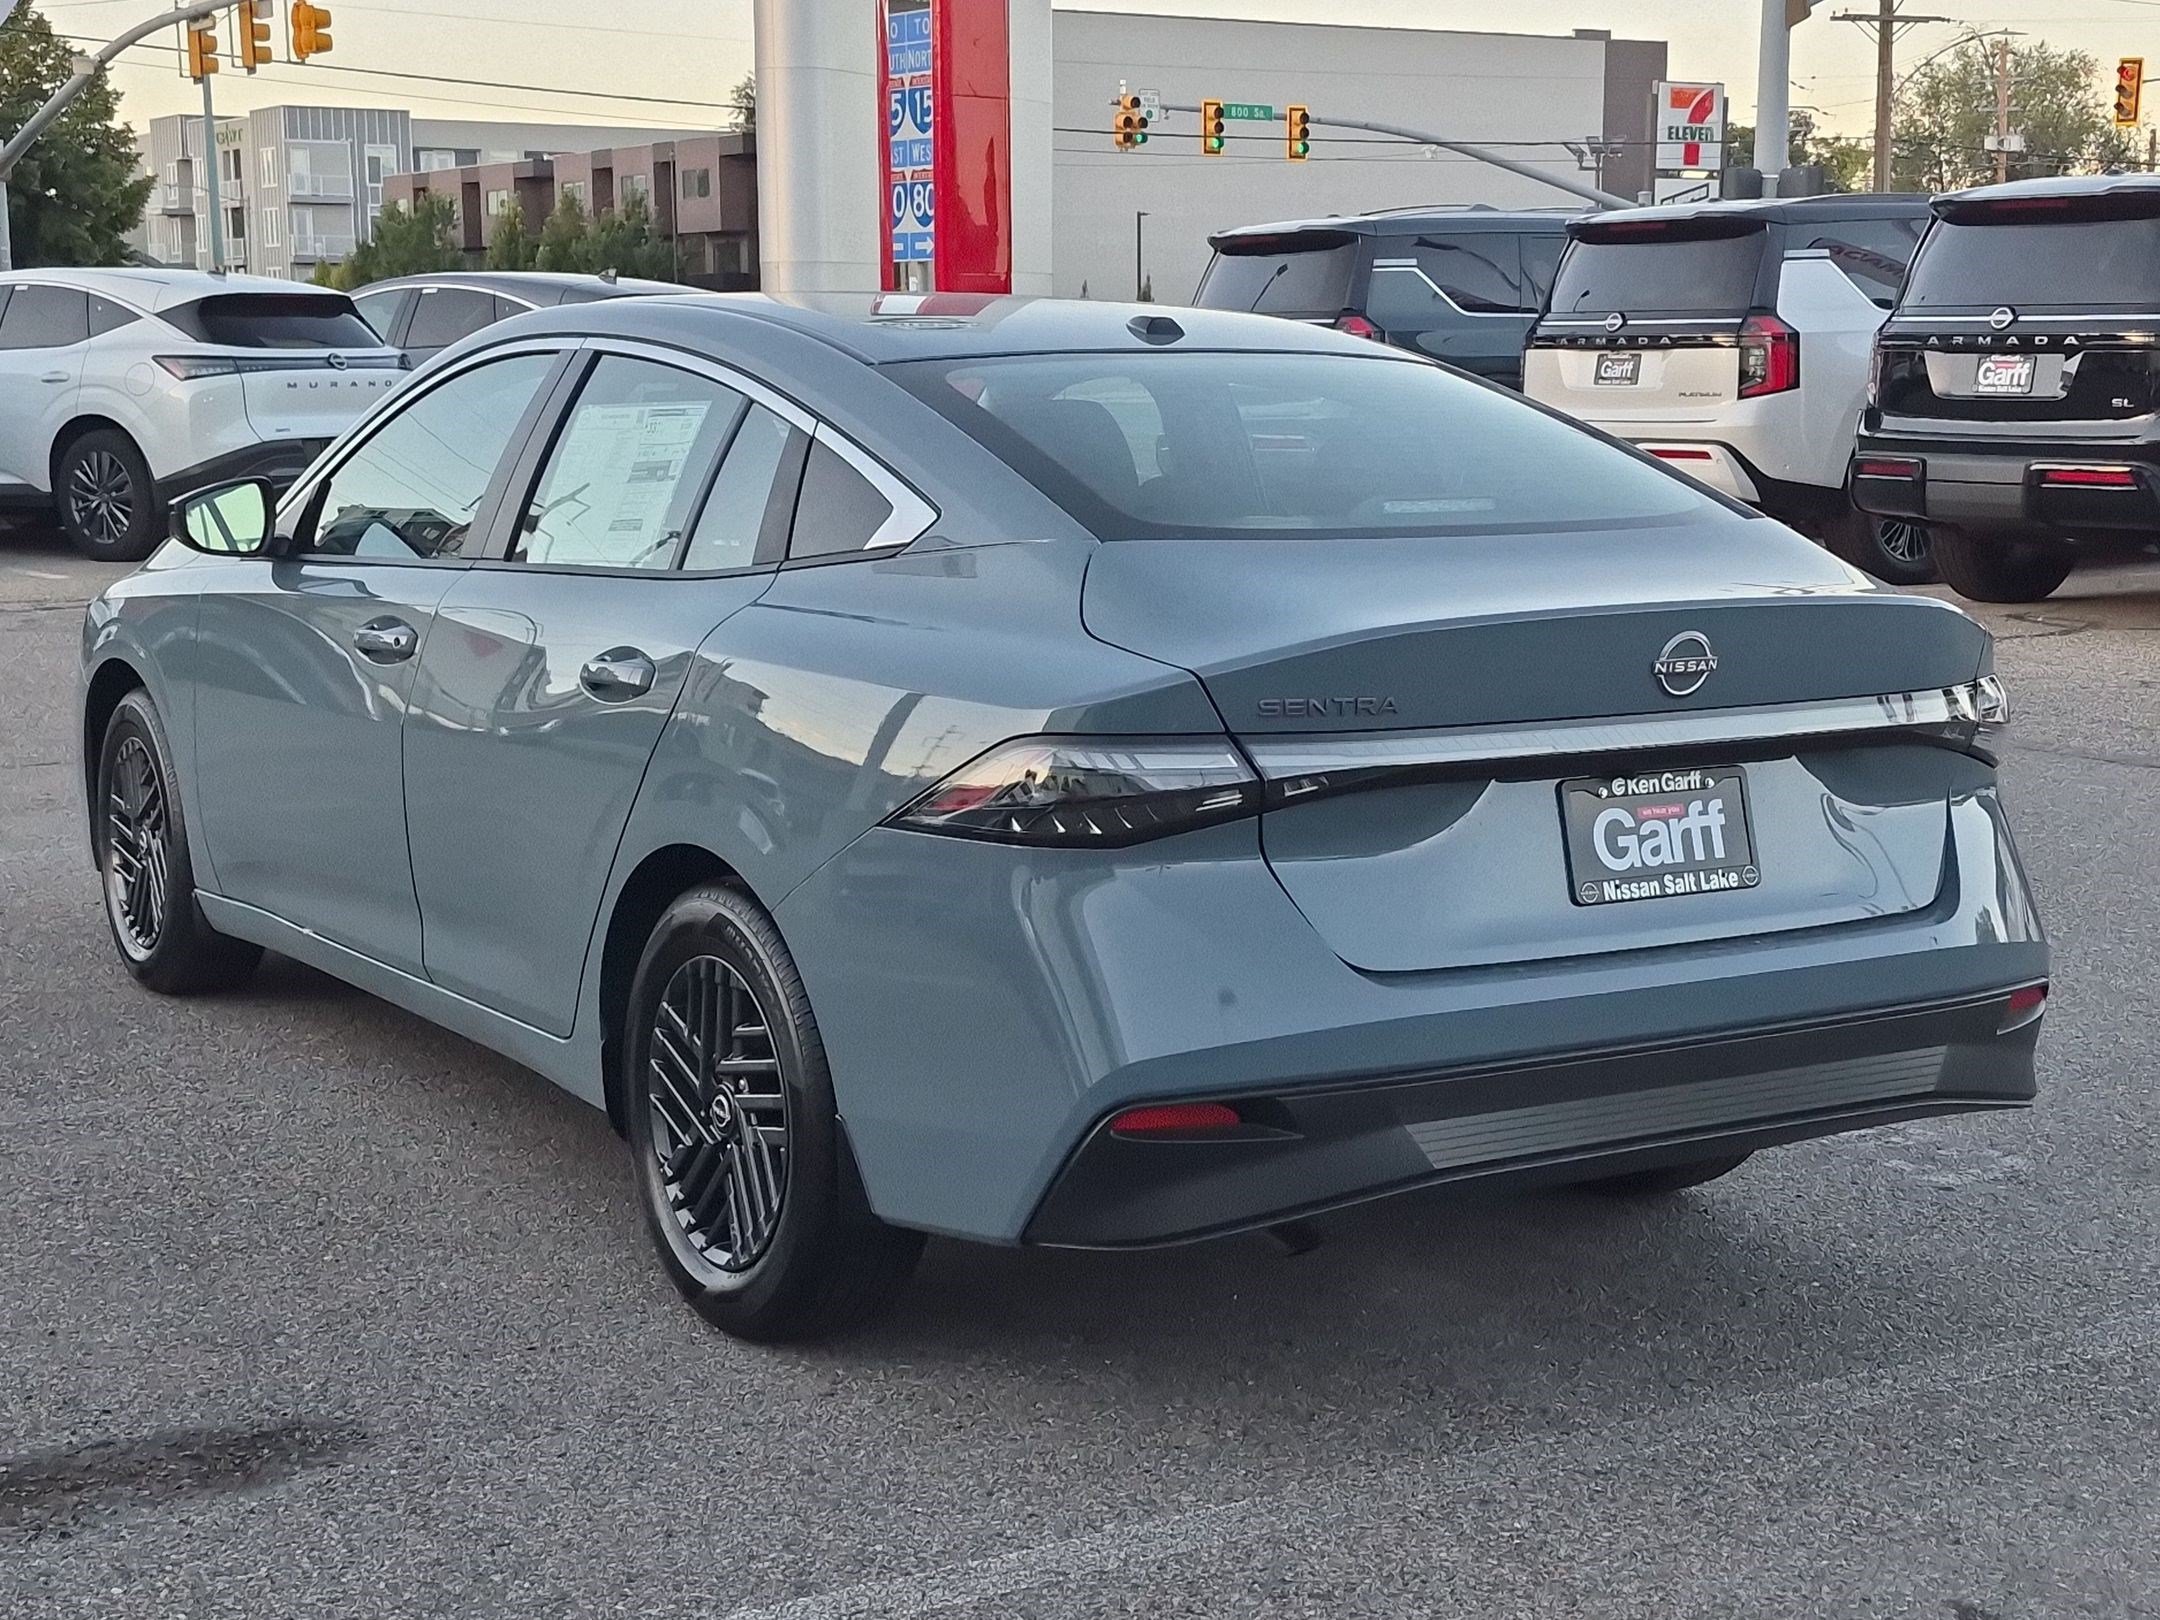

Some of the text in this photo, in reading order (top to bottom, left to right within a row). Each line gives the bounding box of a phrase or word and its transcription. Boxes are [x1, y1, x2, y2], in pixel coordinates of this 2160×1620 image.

[890, 22, 898, 38] O
[914, 18, 930, 34] TO
[890, 51, 906, 70] UTH
[908, 50, 931, 69] NORT
[891, 93, 903, 126] 5
[914, 90, 932, 124] 15
[1231, 106, 1249, 118] 800
[893, 146, 904, 164] ST
[911, 144, 932, 163] WES
[893, 185, 905, 218] 0
[913, 184, 934, 217] 80
[1558, 336, 1671, 346] ARMADA
[1926, 335, 2080, 346] ARMADA
[1601, 361, 1634, 378] Garff
[1978, 361, 2030, 386] Garff
[287, 380, 393, 389] MURANO
[2111, 398, 2135, 408] SL
[1655, 660, 1718, 673] NISSAN
[1257, 696, 1399, 717] SENTRA
[1627, 770, 1702, 796] Ken Garff
[1593, 798, 1726, 872] Garff
[1602, 869, 1739, 901] Nissan Salt Lake
